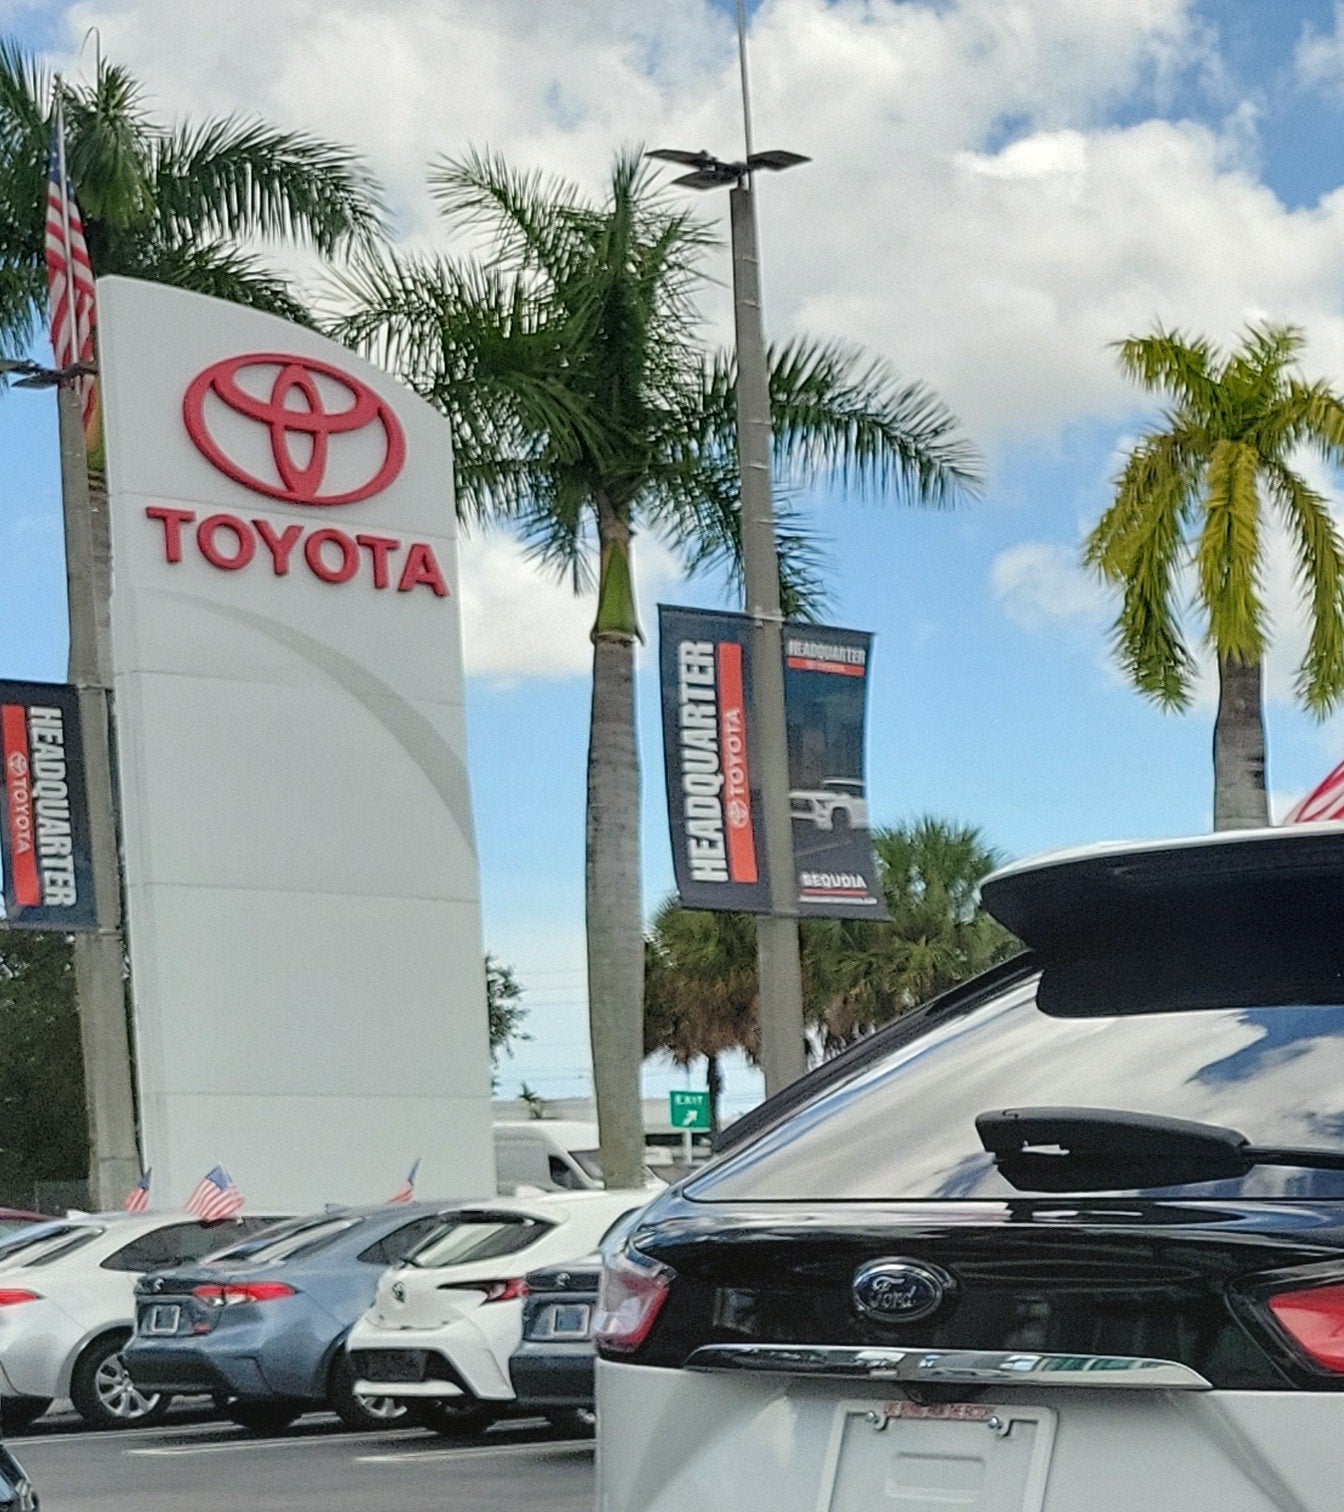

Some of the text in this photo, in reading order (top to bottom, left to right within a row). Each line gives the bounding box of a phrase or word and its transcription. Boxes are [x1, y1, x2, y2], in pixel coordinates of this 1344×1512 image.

[145, 506, 450, 597] TOYOTA
[679, 640, 729, 882] HEADQUARTER
[726, 707, 746, 798] TOYOTA
[13, 778, 31, 854] TOYOTA
[28, 705, 77, 906] HEADQUARTER
[800, 871, 868, 888] SEQUOIA
[675, 1095, 703, 1105] EXIT
[869, 1275, 917, 1309] Ford
